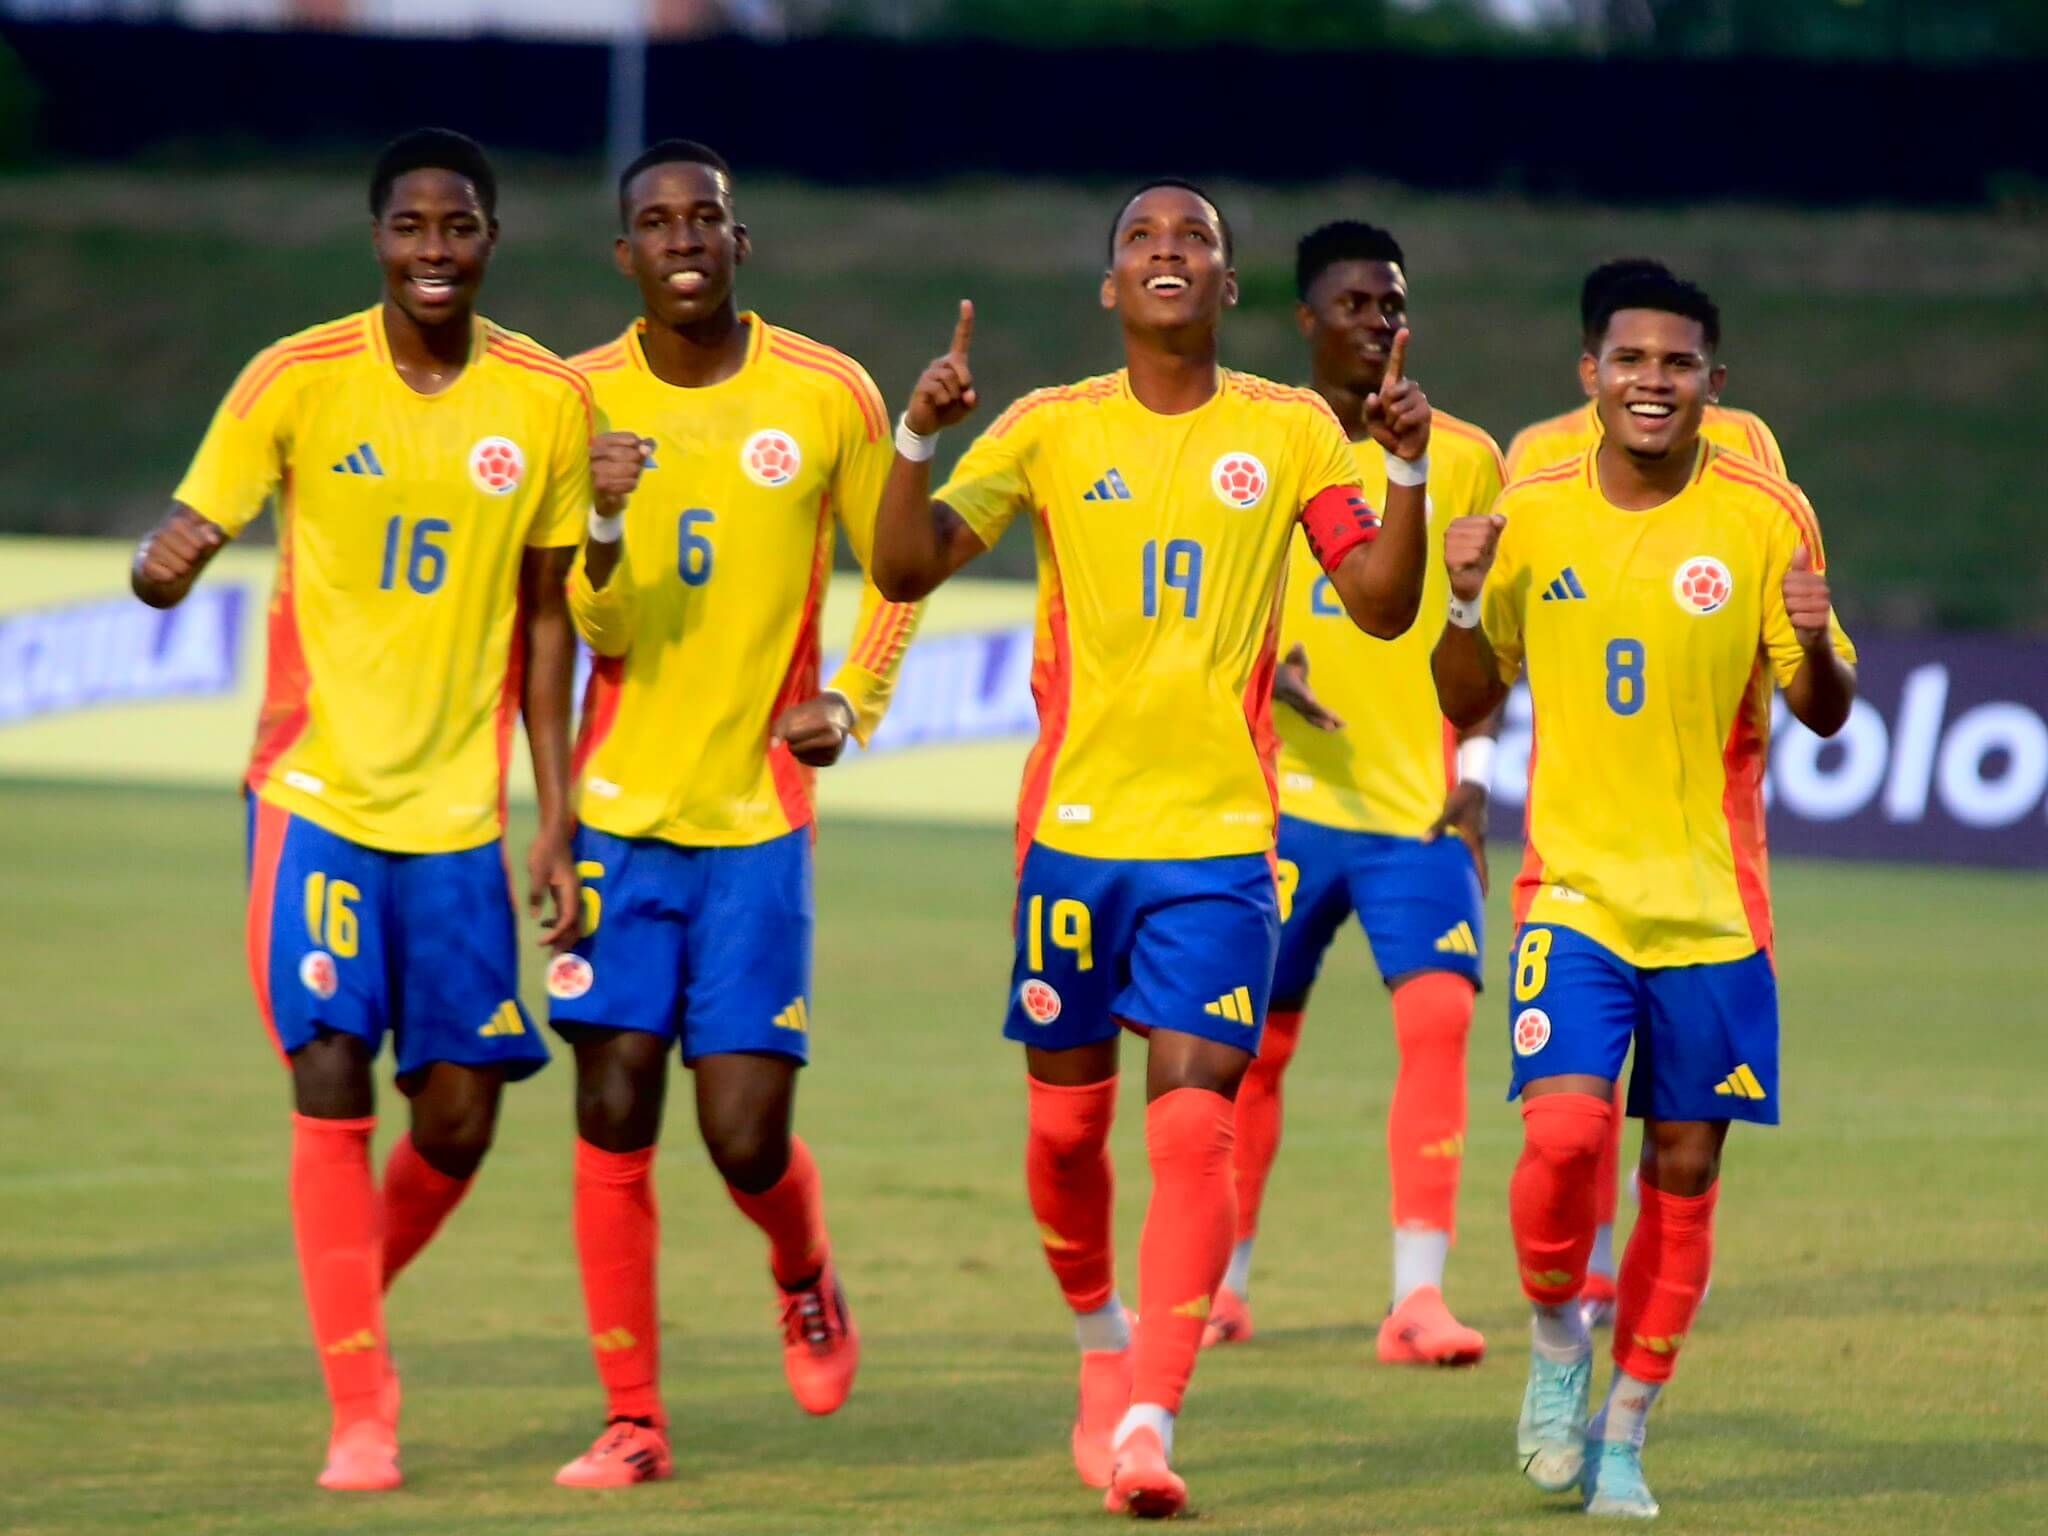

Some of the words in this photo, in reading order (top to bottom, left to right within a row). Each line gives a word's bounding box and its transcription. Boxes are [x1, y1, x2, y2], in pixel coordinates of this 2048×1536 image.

[381, 515, 450, 594] 16
[679, 509, 714, 586] 6
[1143, 539, 1203, 618] 19
[1606, 638, 1645, 716] 8
[1765, 664, 2048, 829] olo
[305, 872, 362, 959] 16
[1027, 894, 1094, 973] 19
[1514, 927, 1553, 1003] 8
